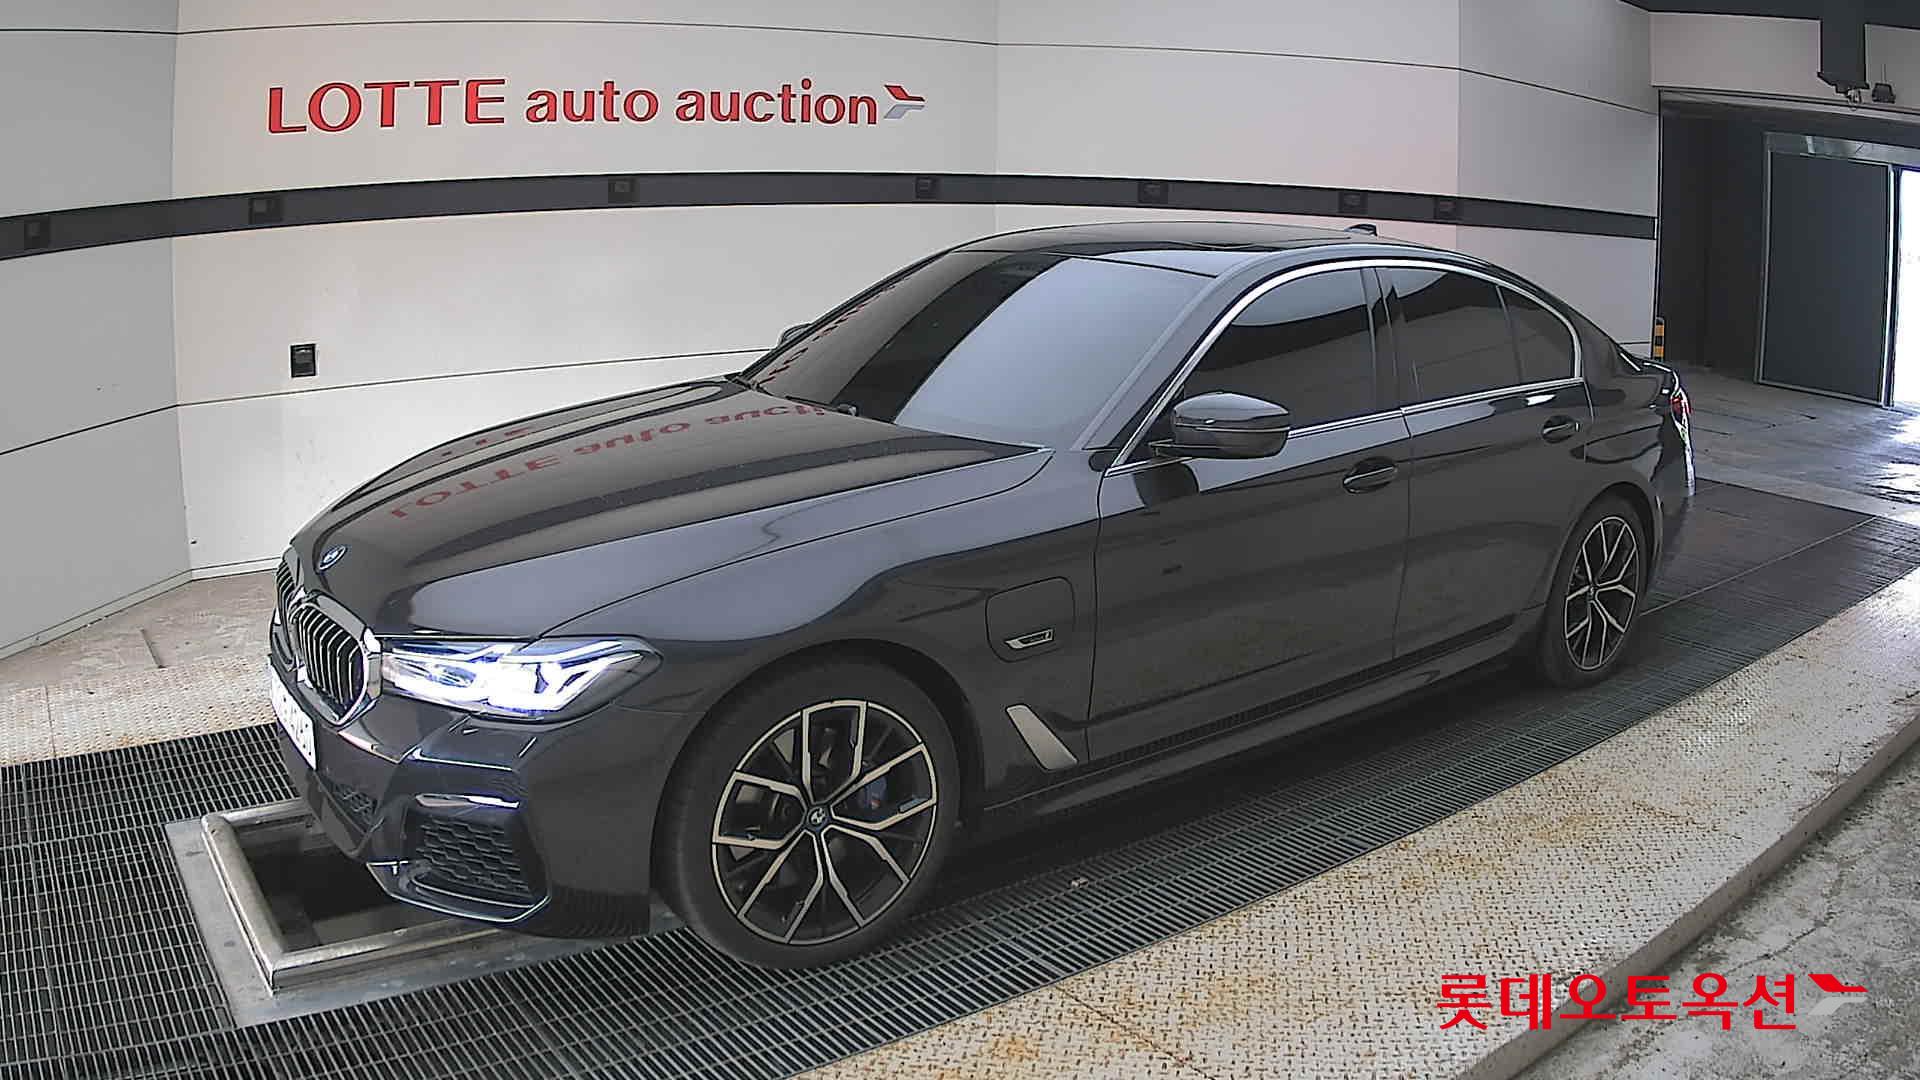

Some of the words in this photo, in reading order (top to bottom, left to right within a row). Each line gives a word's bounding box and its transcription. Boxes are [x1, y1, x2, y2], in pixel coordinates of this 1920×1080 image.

[266, 79, 506, 134] LOTTE
[526, 81, 659, 124] auto
[677, 78, 879, 126] auction
